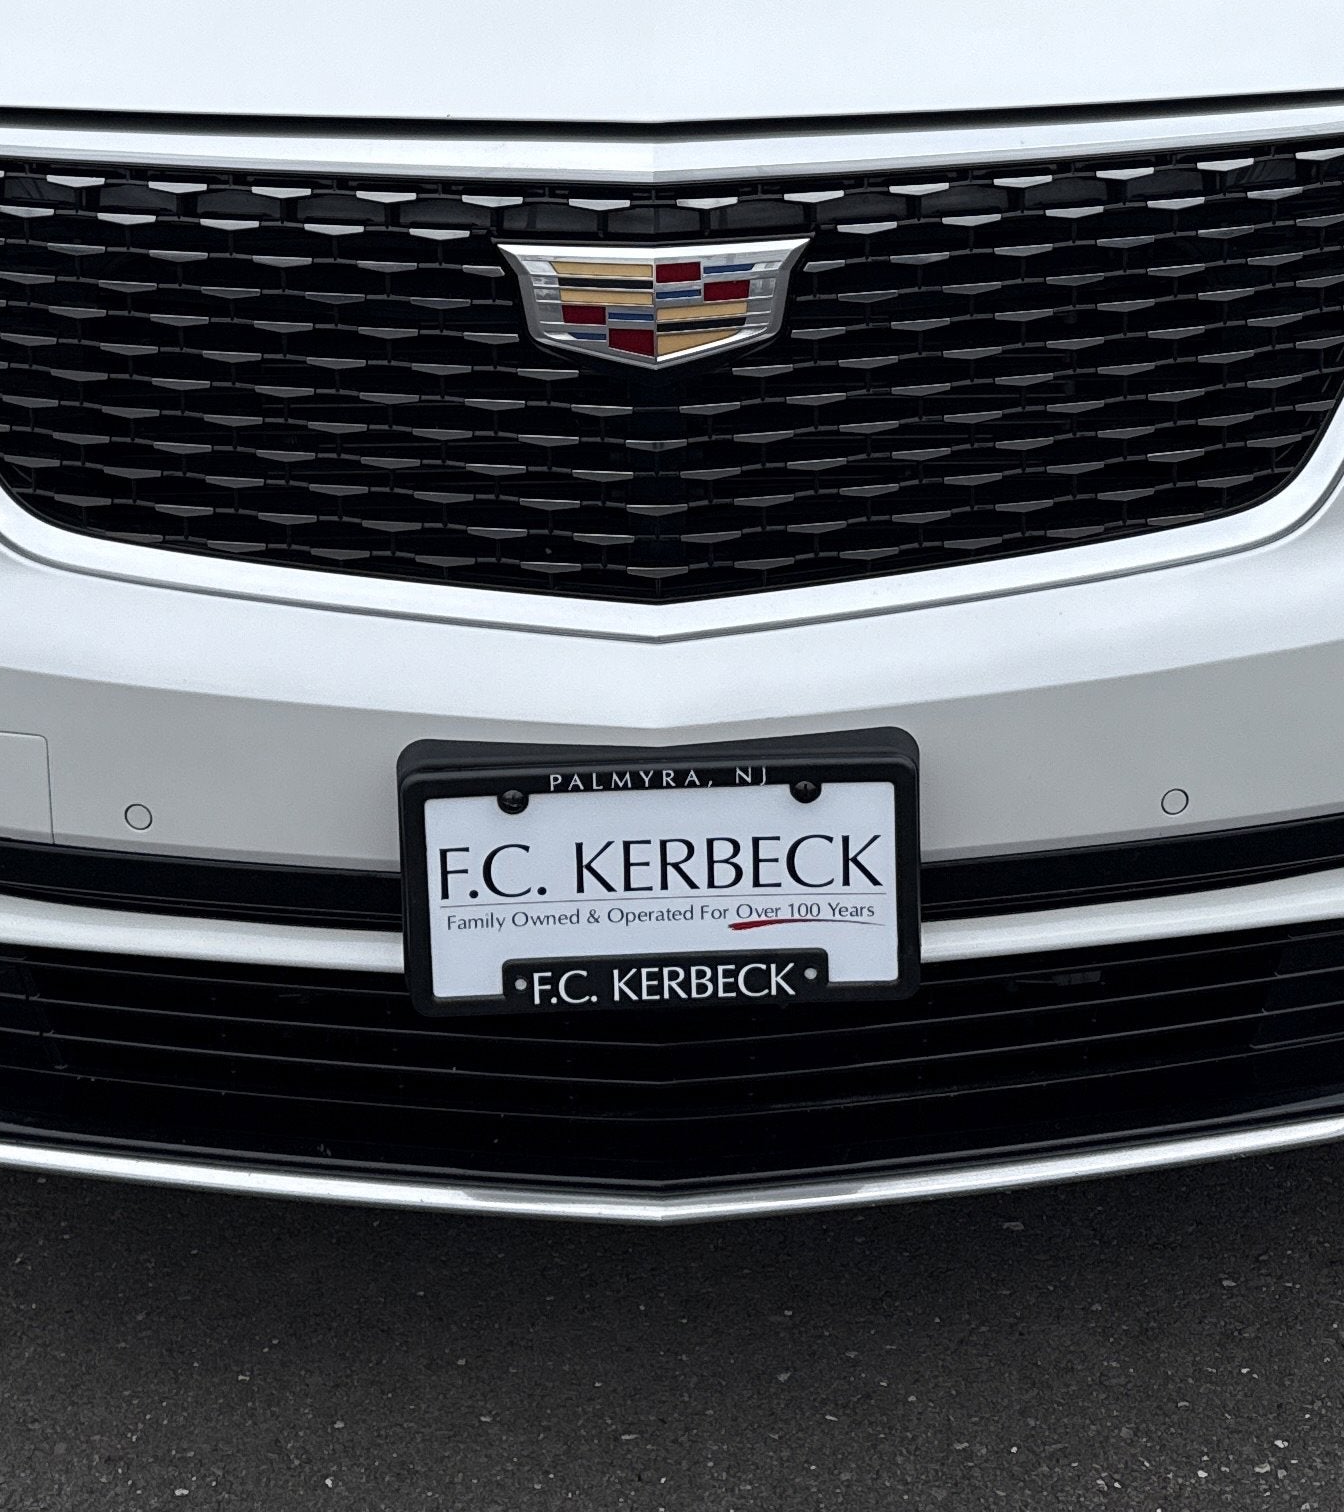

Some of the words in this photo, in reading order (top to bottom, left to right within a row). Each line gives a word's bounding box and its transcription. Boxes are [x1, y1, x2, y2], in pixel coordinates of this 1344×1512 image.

[548, 766, 715, 792] PALMYRA,
[734, 766, 769, 788] NJ
[437, 842, 548, 901] F.C.
[574, 834, 884, 895] KERBECK
[446, 912, 506, 932] Family
[510, 908, 581, 927] Owned
[587, 908, 602, 925] &
[606, 903, 696, 926] Operated
[700, 905, 731, 922] For
[735, 903, 782, 921] Over
[786, 902, 822, 919] 100
[827, 901, 876, 919] Years
[532, 969, 599, 1006] F.C.
[611, 962, 797, 1002] KERBECK
